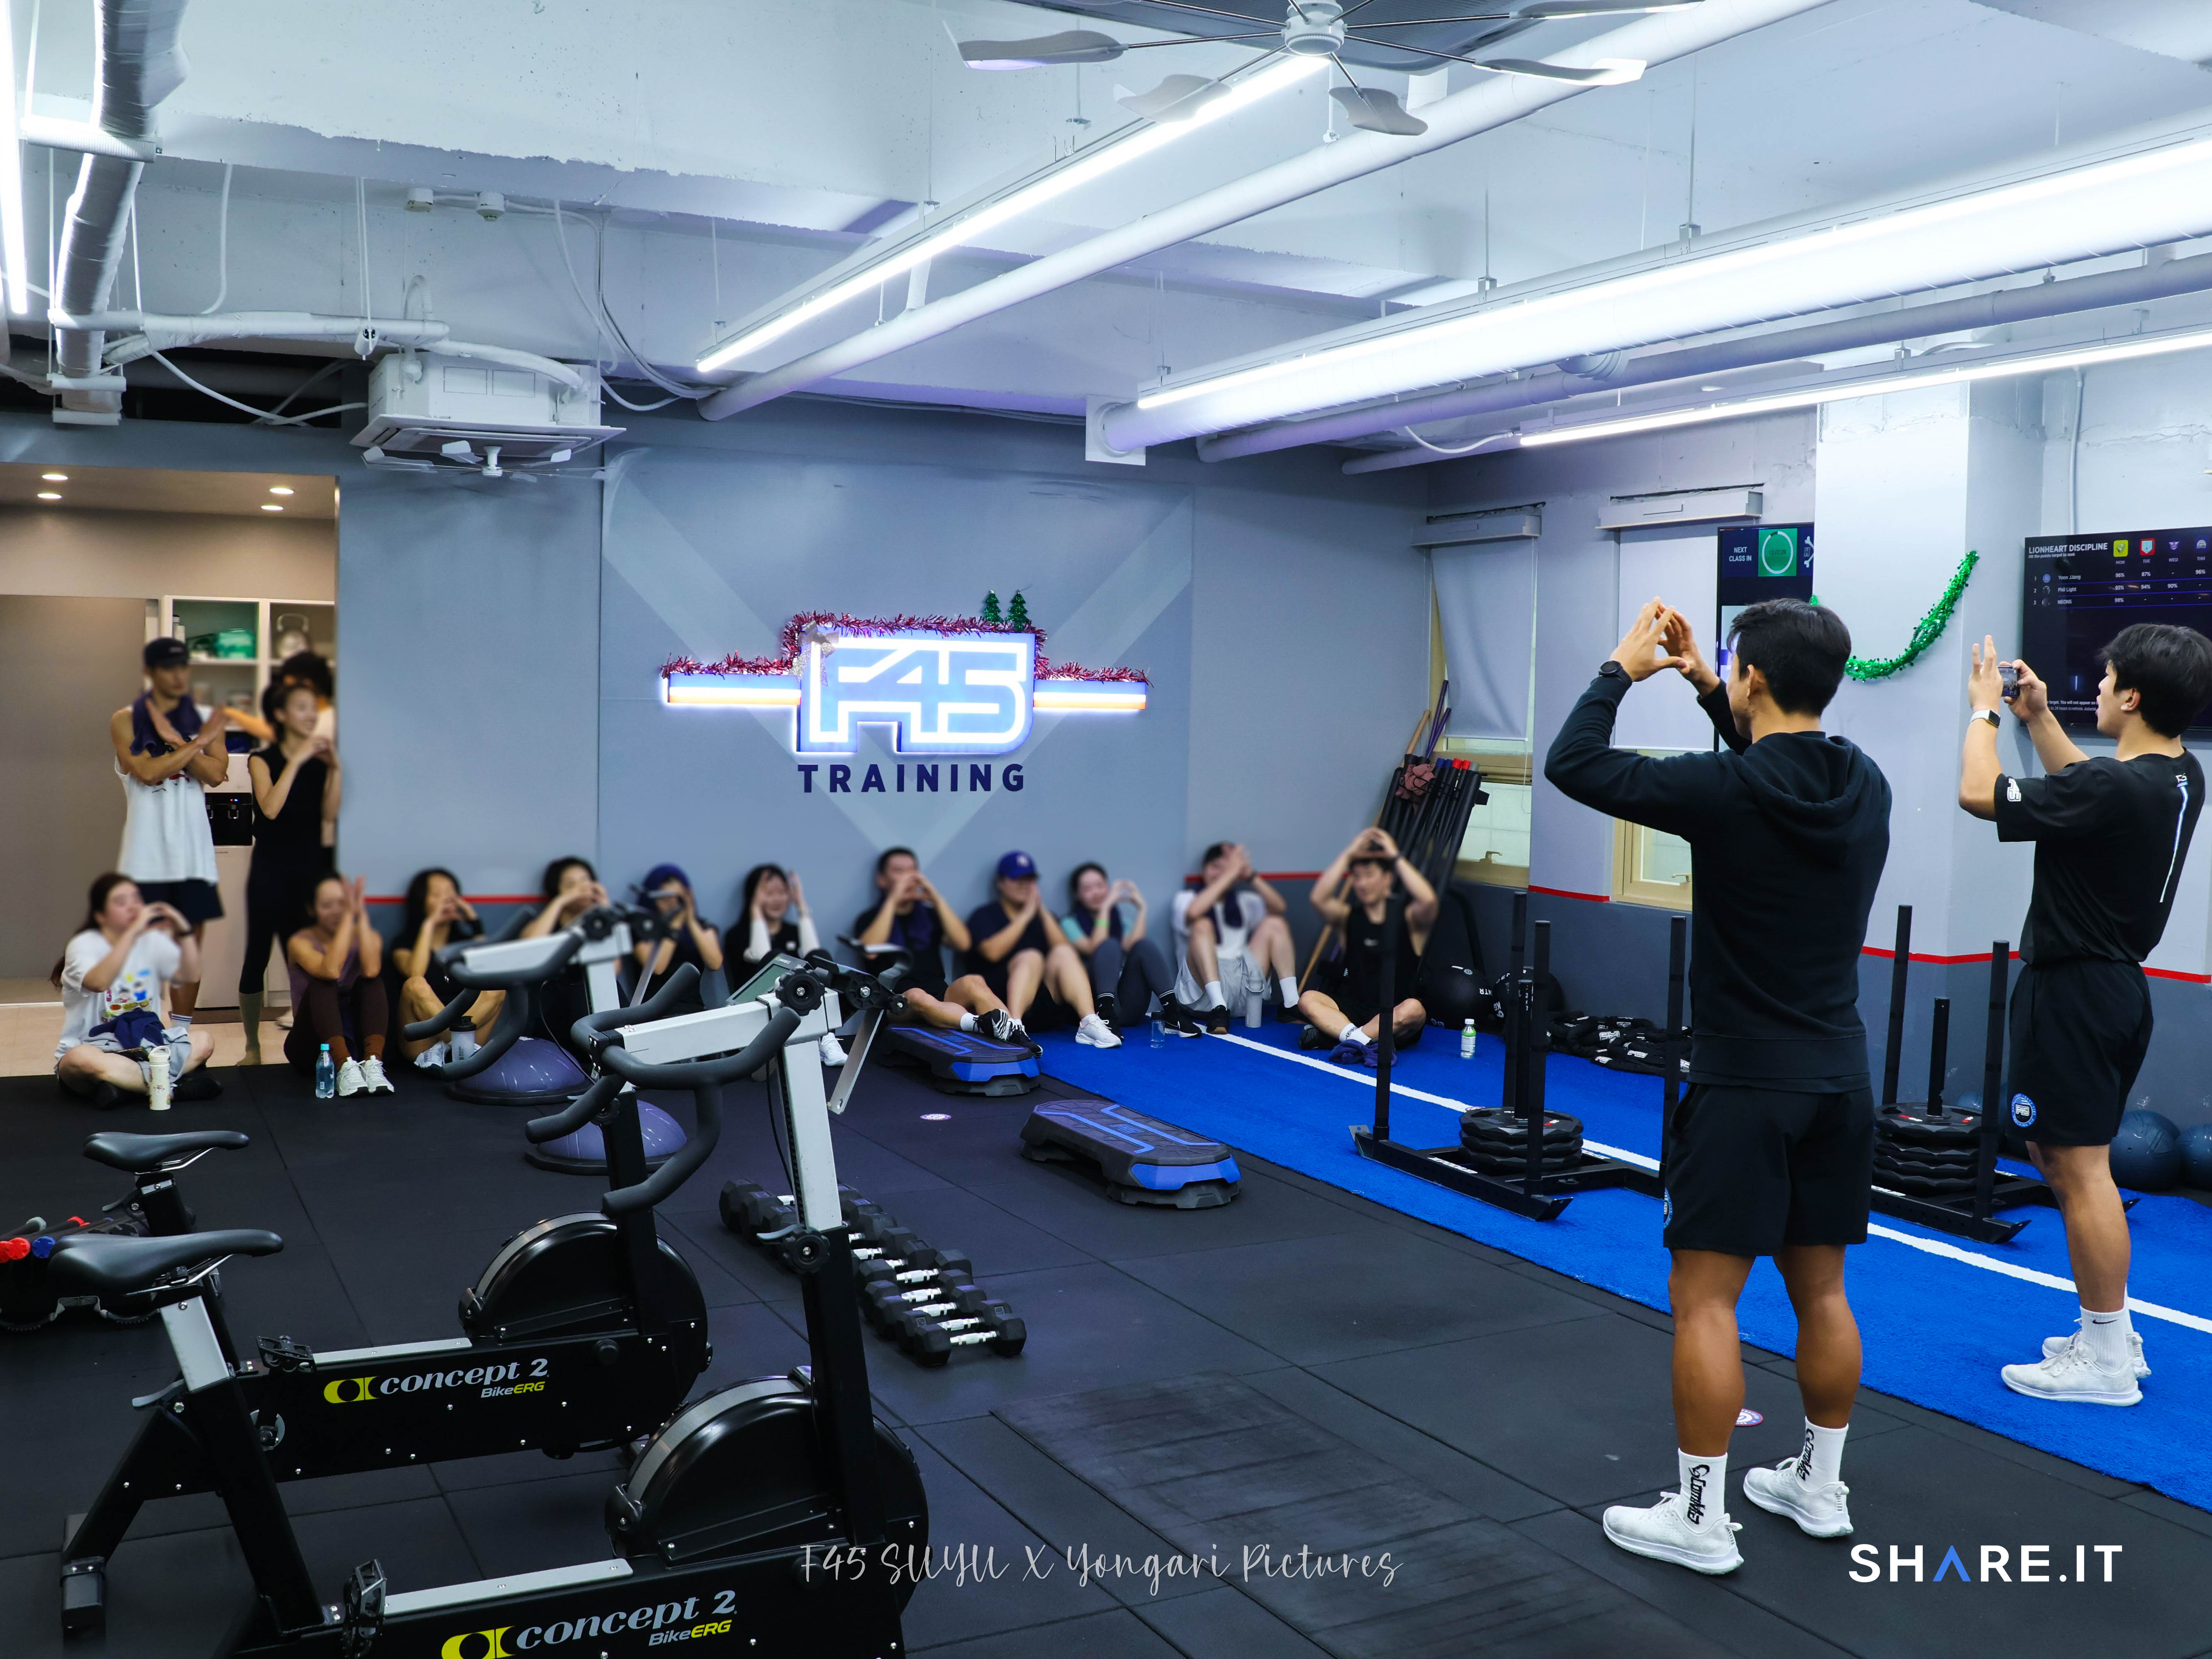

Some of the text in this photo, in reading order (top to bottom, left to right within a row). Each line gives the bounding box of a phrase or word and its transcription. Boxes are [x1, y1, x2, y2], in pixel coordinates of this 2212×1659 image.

[2029, 542, 2108, 554] LIONHEART DISCIPLINE
[808, 635, 1029, 745] F45
[797, 763, 1024, 793] TRAINING
[2015, 1104, 2029, 1116] F45
[380, 1358, 548, 1394] concept 2
[481, 1381, 545, 1398] BikeERG
[516, 1590, 736, 1649] concept 2
[648, 1619, 732, 1647] BikeERG
